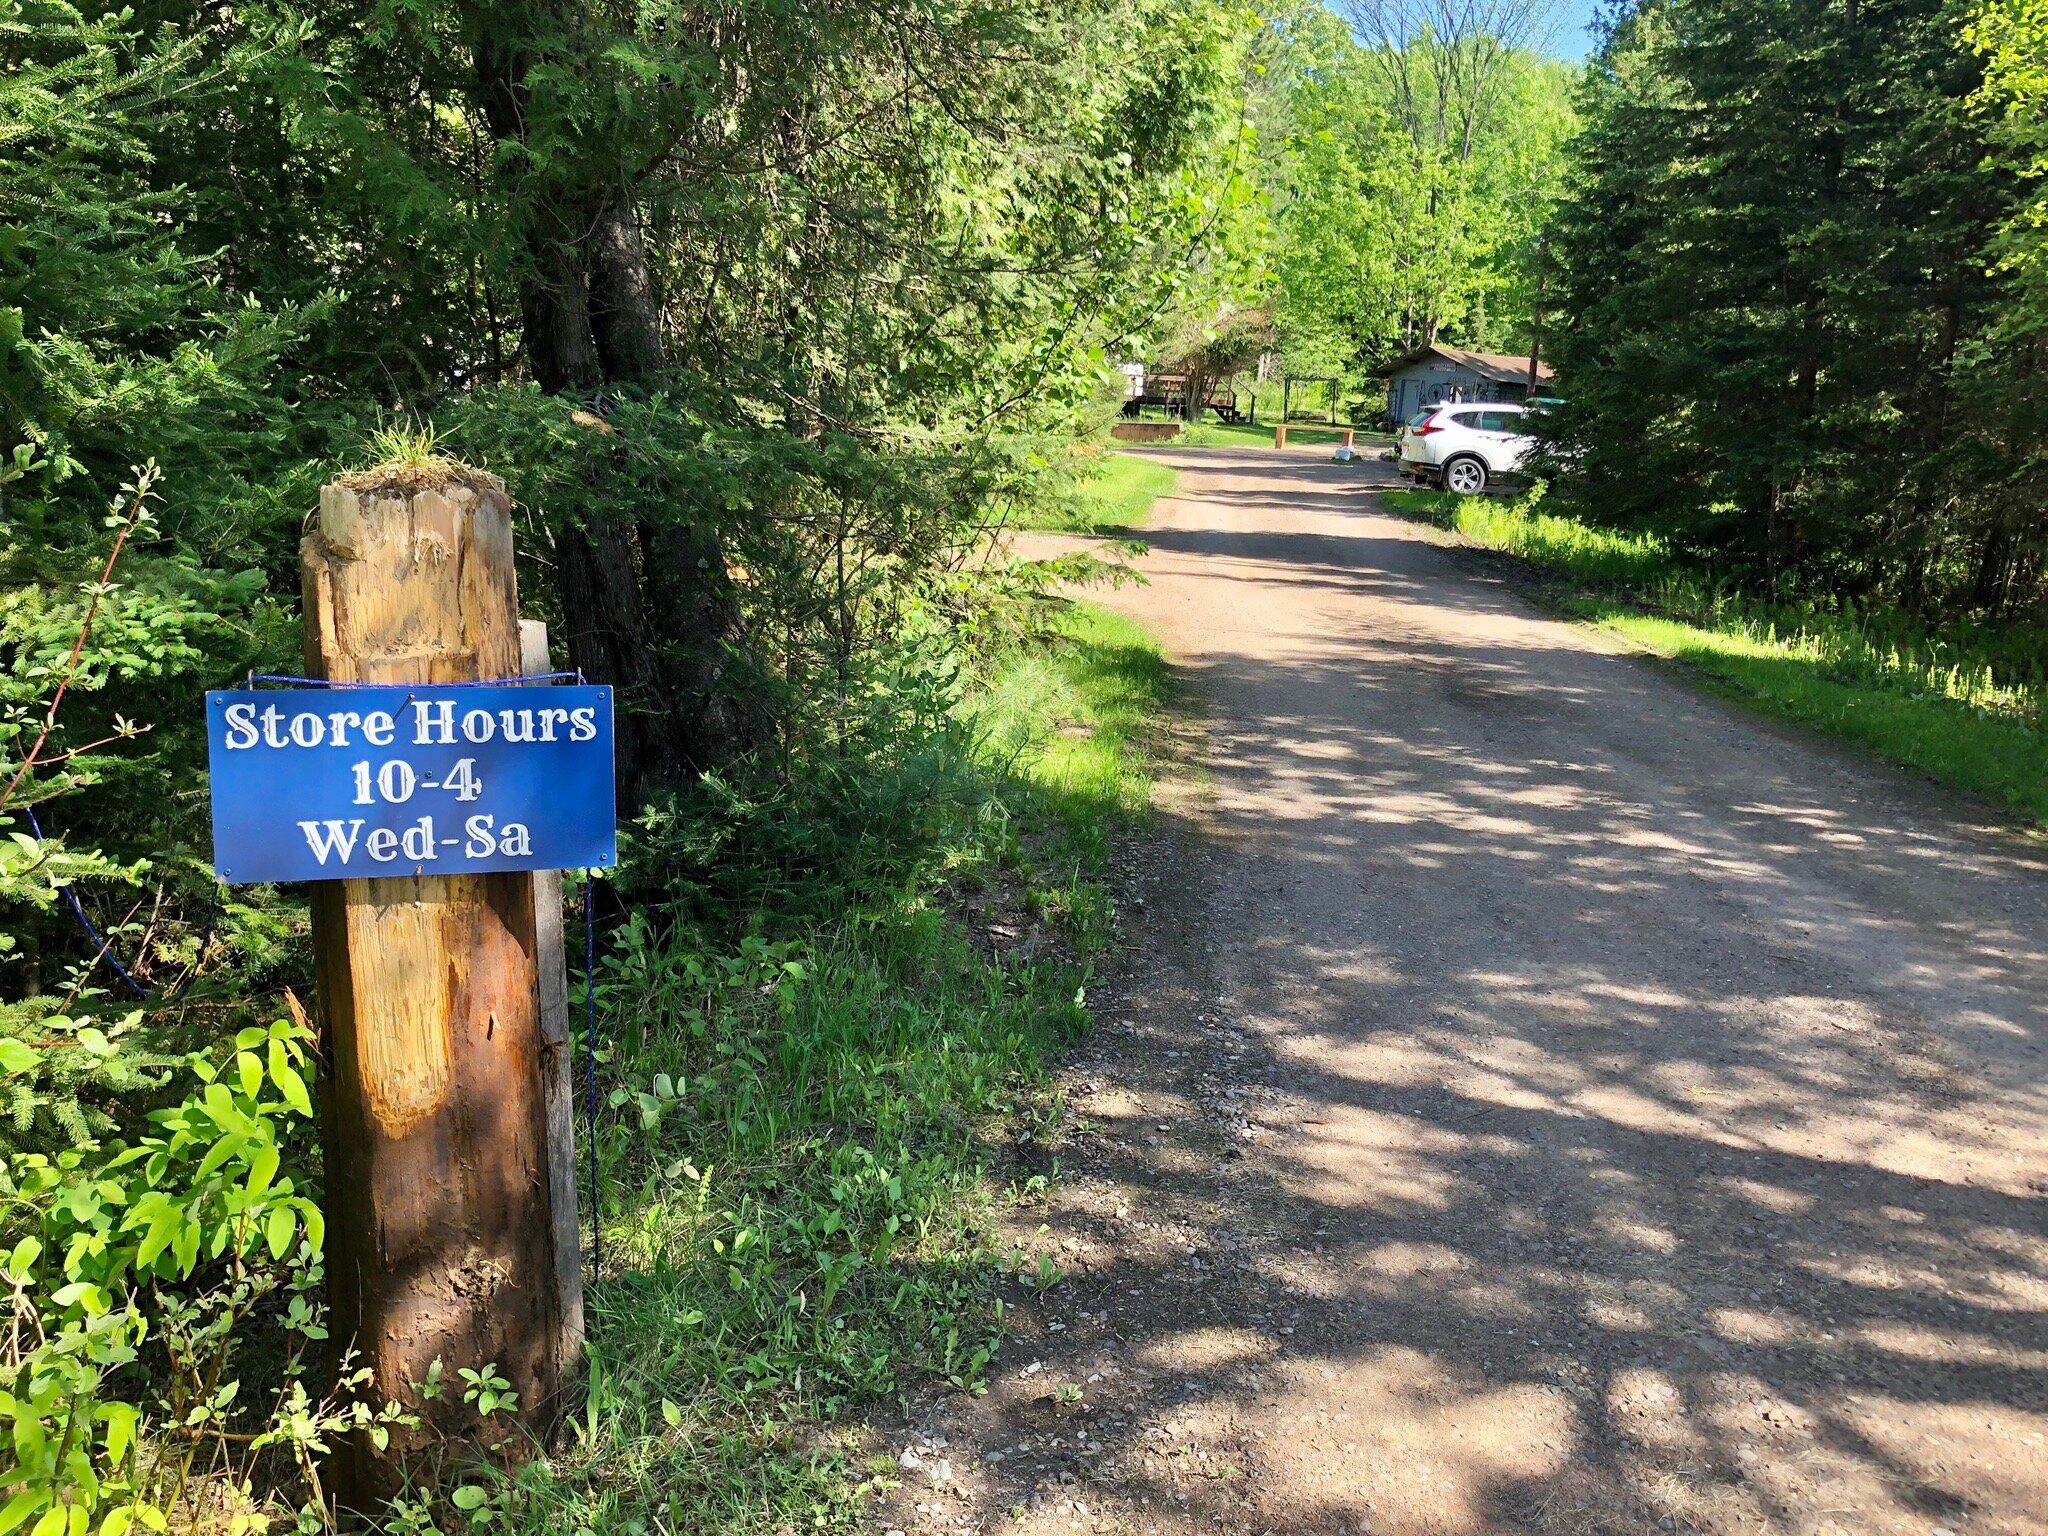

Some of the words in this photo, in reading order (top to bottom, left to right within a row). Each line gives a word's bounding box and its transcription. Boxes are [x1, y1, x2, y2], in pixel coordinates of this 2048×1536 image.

[224, 702, 395, 750] Store
[411, 700, 597, 745] Hours
[351, 758, 483, 805] 10-4
[296, 813, 534, 866] Wed-Sa
